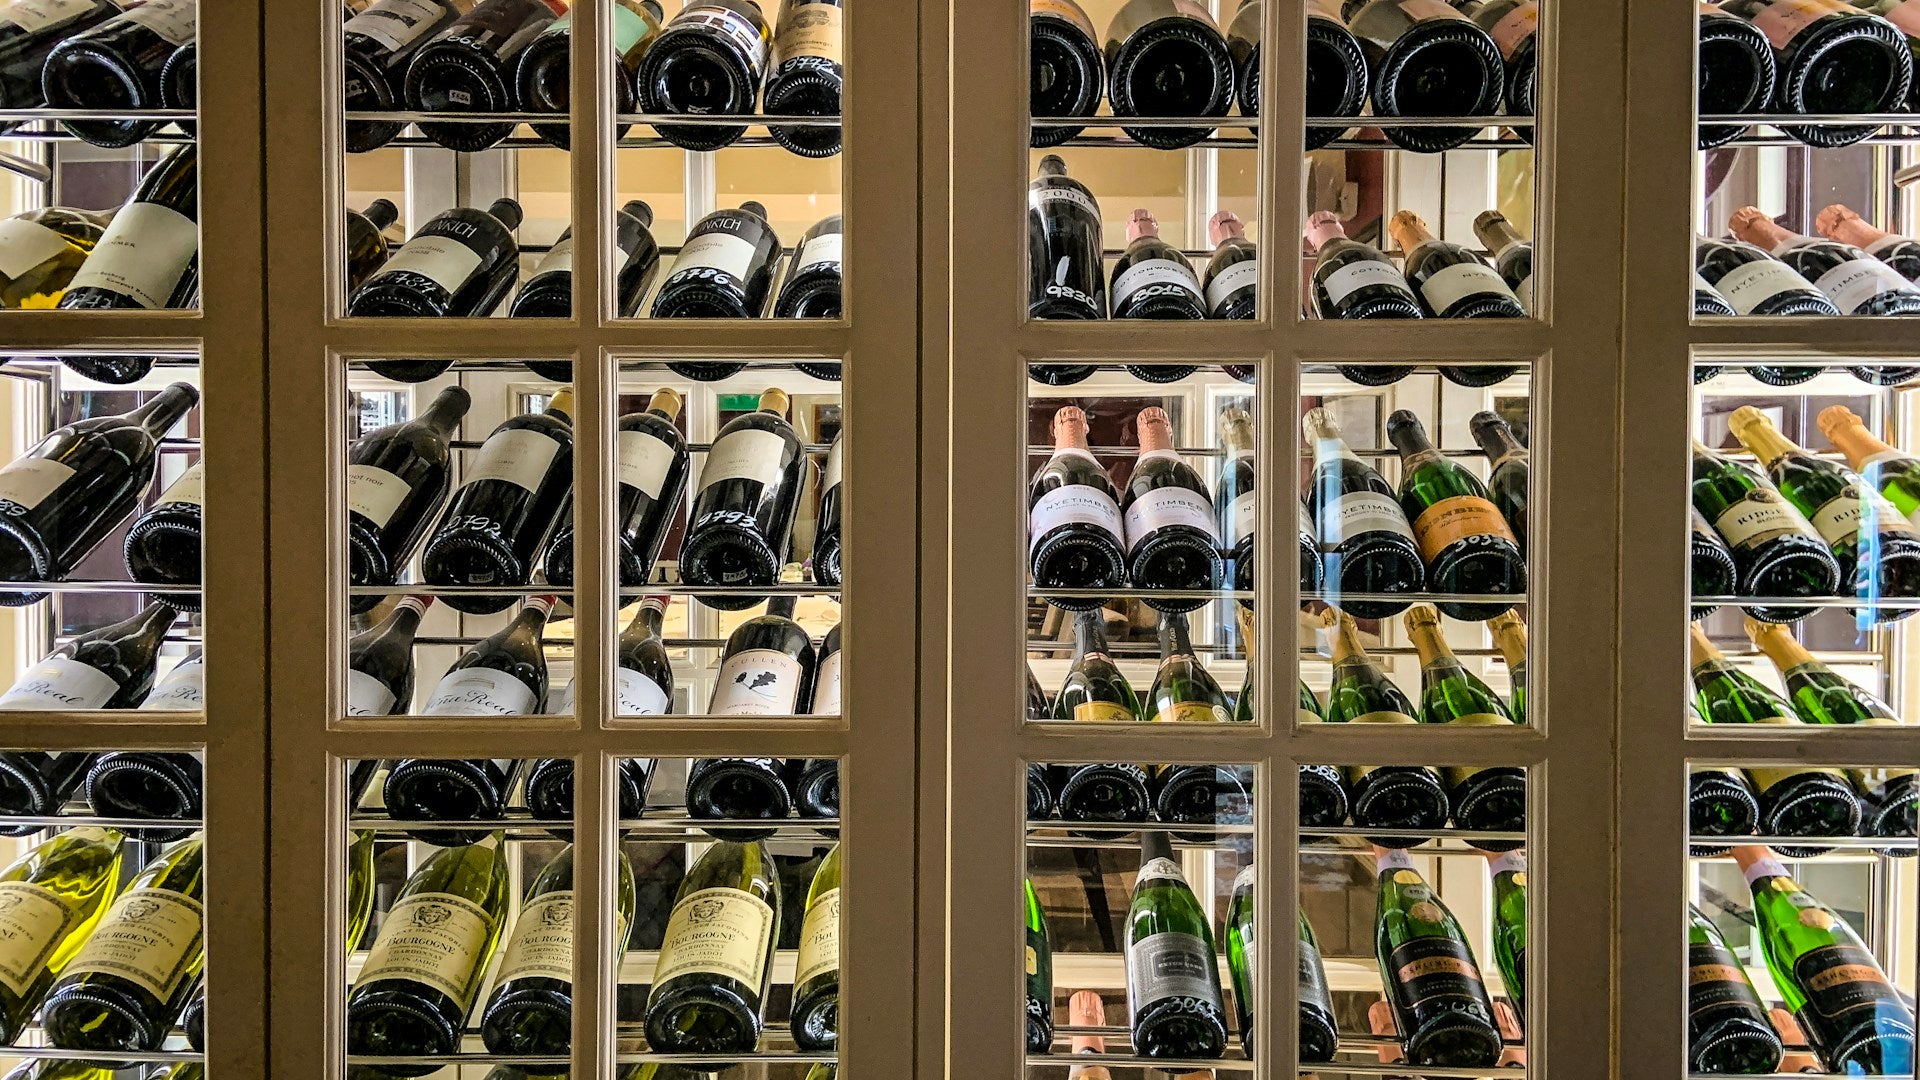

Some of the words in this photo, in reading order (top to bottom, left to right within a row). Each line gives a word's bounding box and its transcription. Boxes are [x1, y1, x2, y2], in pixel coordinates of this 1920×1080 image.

[672, 268, 732, 285] 9786
[1046, 285, 1099, 310] 9830
[366, 477, 385, 487] noir
[1046, 498, 1116, 517] NYETIMBER
[730, 657, 787, 669] CULLEN
[24, 680, 84, 705] Real
[465, 690, 517, 715] Real
[387, 936, 456, 955] BOURGOGNE
[519, 935, 572, 947] BOURGOG
[670, 931, 736, 949] BOURGOGNE
[521, 947, 571, 955] CHARDONNA
